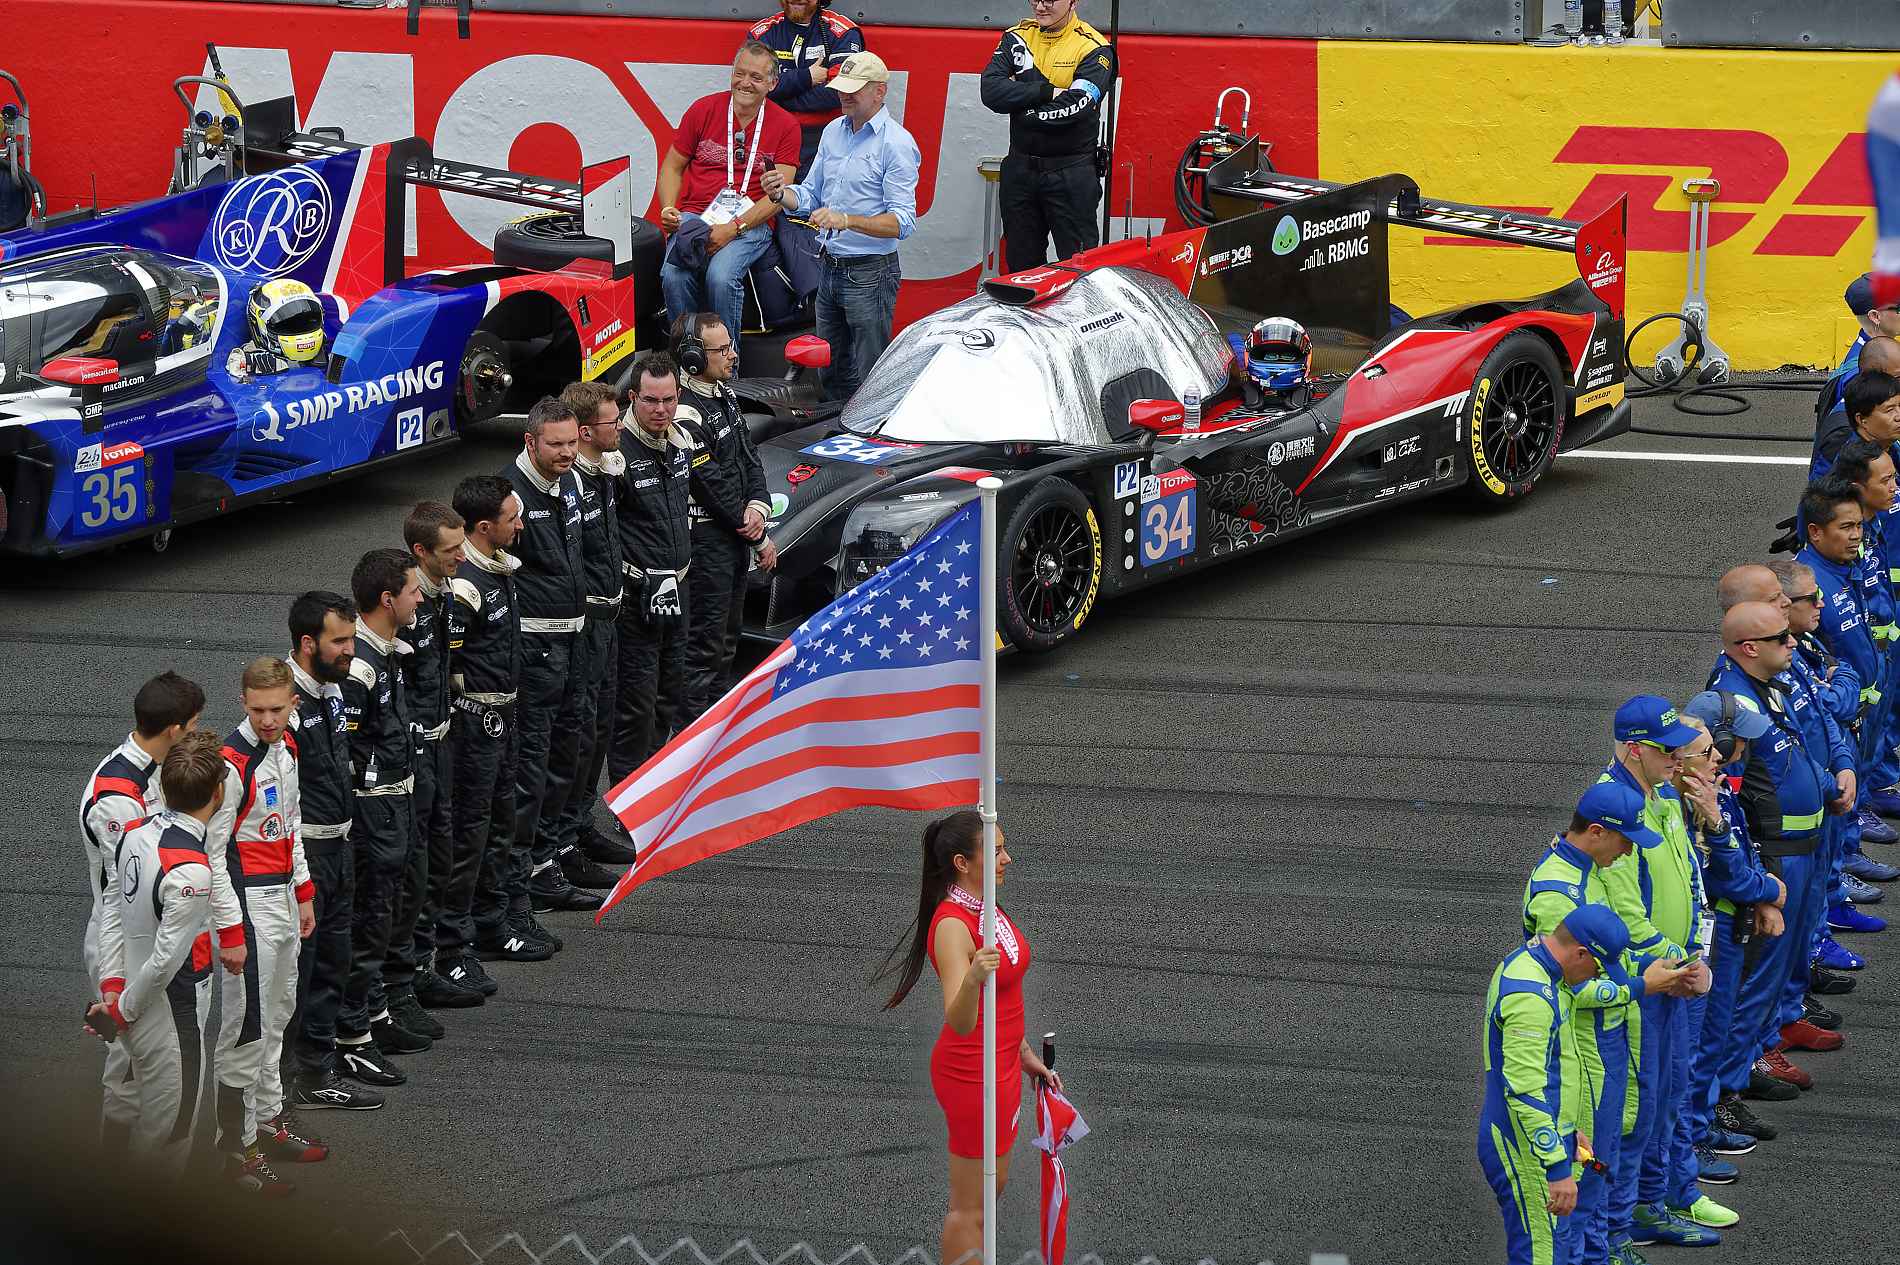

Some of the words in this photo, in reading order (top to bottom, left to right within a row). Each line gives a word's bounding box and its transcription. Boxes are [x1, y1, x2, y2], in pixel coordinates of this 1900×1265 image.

[1303, 209, 1370, 241] Basecamp
[1327, 236, 1369, 264] RBMG
[595, 319, 623, 345] MOTUL
[1080, 311, 1125, 334] onroak
[600, 340, 626, 362] DUNLOP
[102, 375, 145, 393] macari.com
[286, 392, 342, 429] SMP
[344, 361, 443, 413] RACING
[85, 405, 103, 416] OMP
[400, 415, 420, 445] P2
[1473, 387, 1495, 481] DUNLOP
[104, 446, 142, 461] TOTAL
[813, 438, 894, 462] 34
[1117, 464, 1137, 493] P2
[1162, 475, 1196, 489] TOTAL
[82, 466, 137, 527] 35
[1145, 496, 1192, 560] 34
[450, 626, 465, 634] eta
[343, 706, 362, 715] eta
